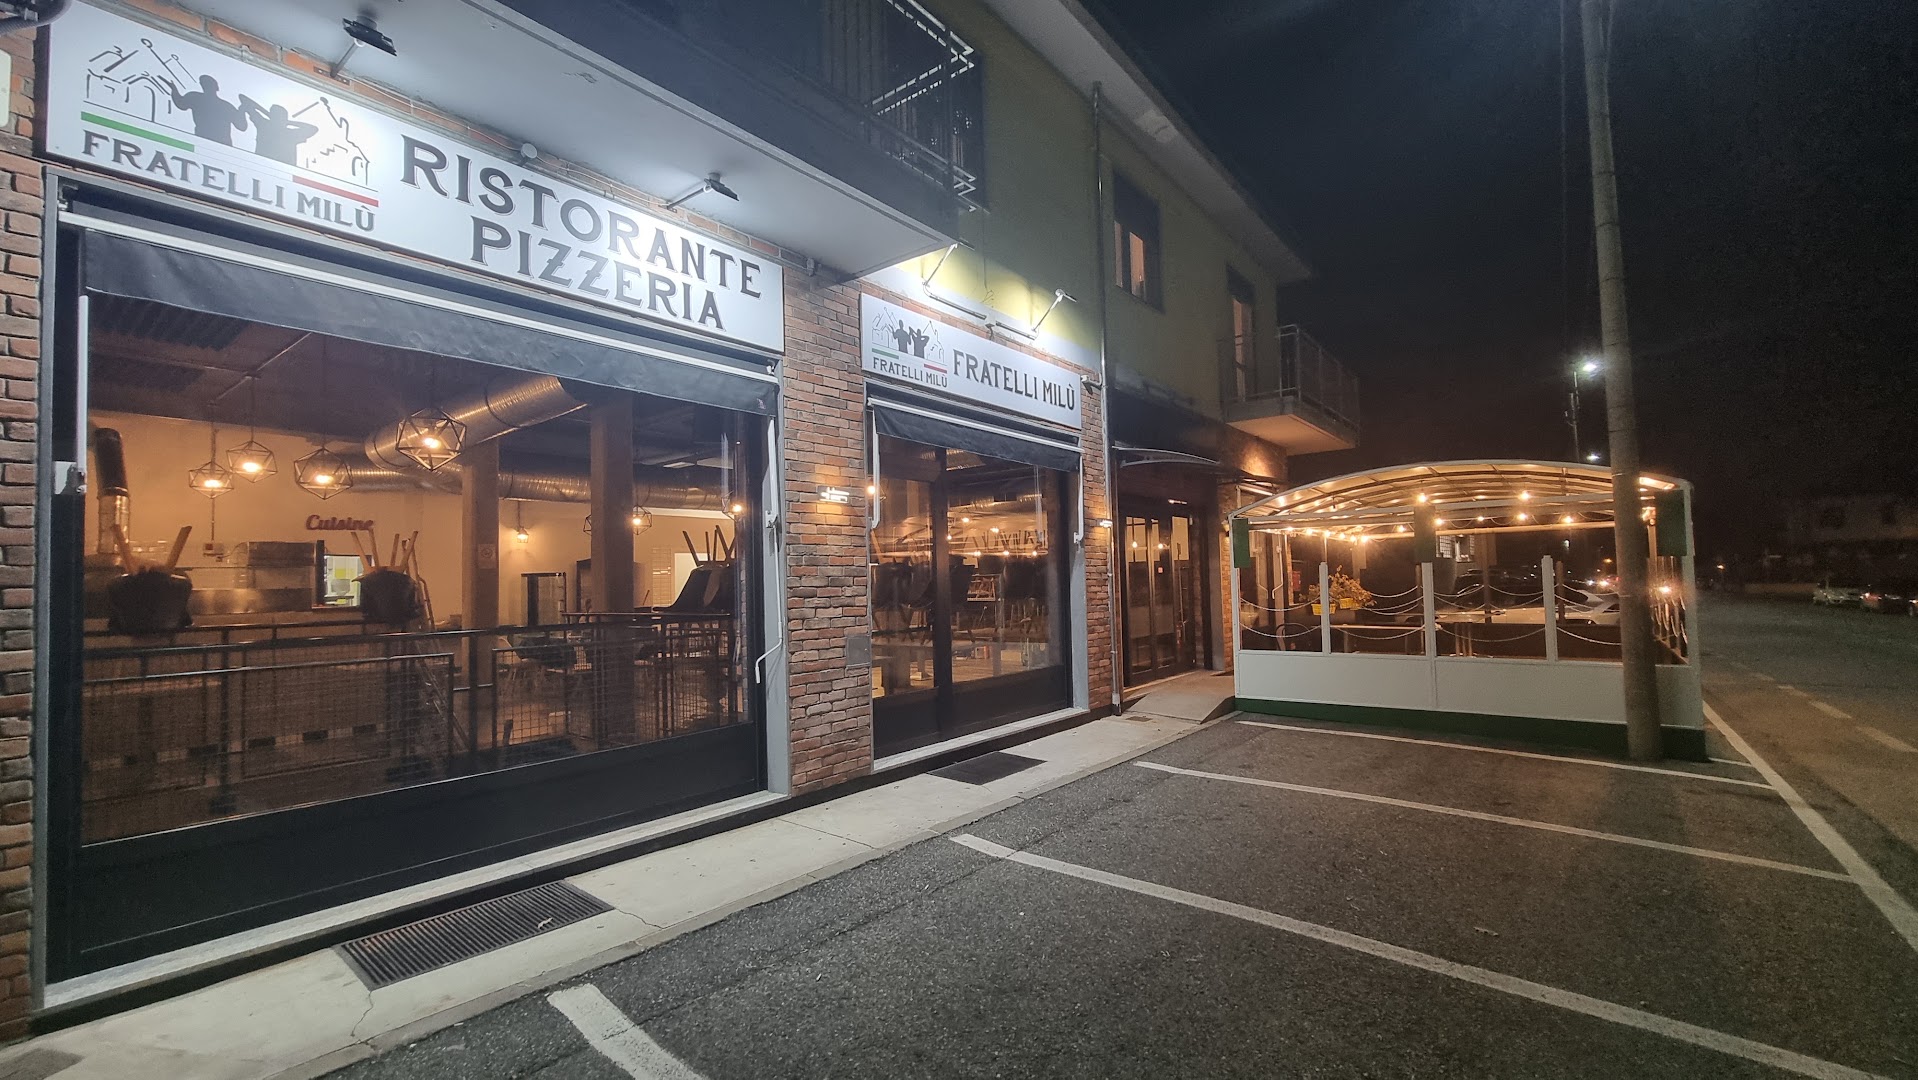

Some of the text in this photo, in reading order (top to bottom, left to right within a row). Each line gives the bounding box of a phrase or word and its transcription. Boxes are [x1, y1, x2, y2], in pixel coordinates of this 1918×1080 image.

[81, 129, 376, 232] FRATELLI MILÙ
[400, 133, 762, 299] RISTORANTE
[470, 215, 726, 332] PIZZERIA
[873, 356, 948, 388] FRATELLI MILÙ
[953, 349, 1075, 411] FRATELLI MILÙ
[306, 514, 373, 531] Cuisine
